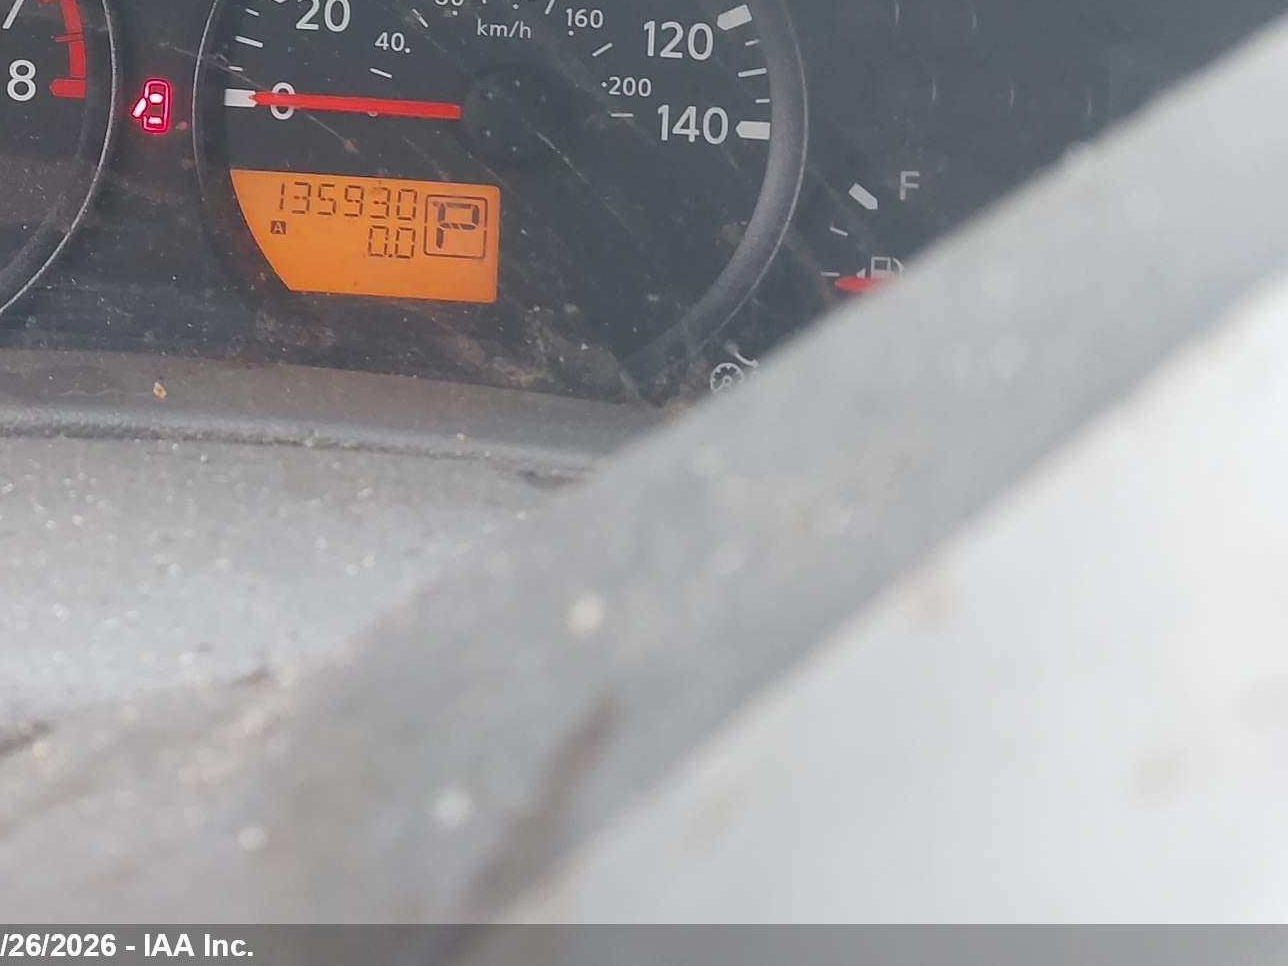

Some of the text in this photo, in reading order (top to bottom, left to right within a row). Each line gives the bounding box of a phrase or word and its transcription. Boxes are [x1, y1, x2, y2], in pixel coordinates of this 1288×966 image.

[476, 16, 532, 41] km/h
[566, 7, 604, 29] 160
[374, 32, 403, 52] 40
[643, 20, 714, 61] 120
[7, 59, 37, 102] 8
[609, 76, 652, 97] 200
[270, 82, 296, 120] 0
[657, 104, 729, 145] 140
[278, 181, 418, 221] 135930
[899, 170, 921, 201] F
[367, 225, 416, 259] 0.0
[433, 201, 481, 250] P
